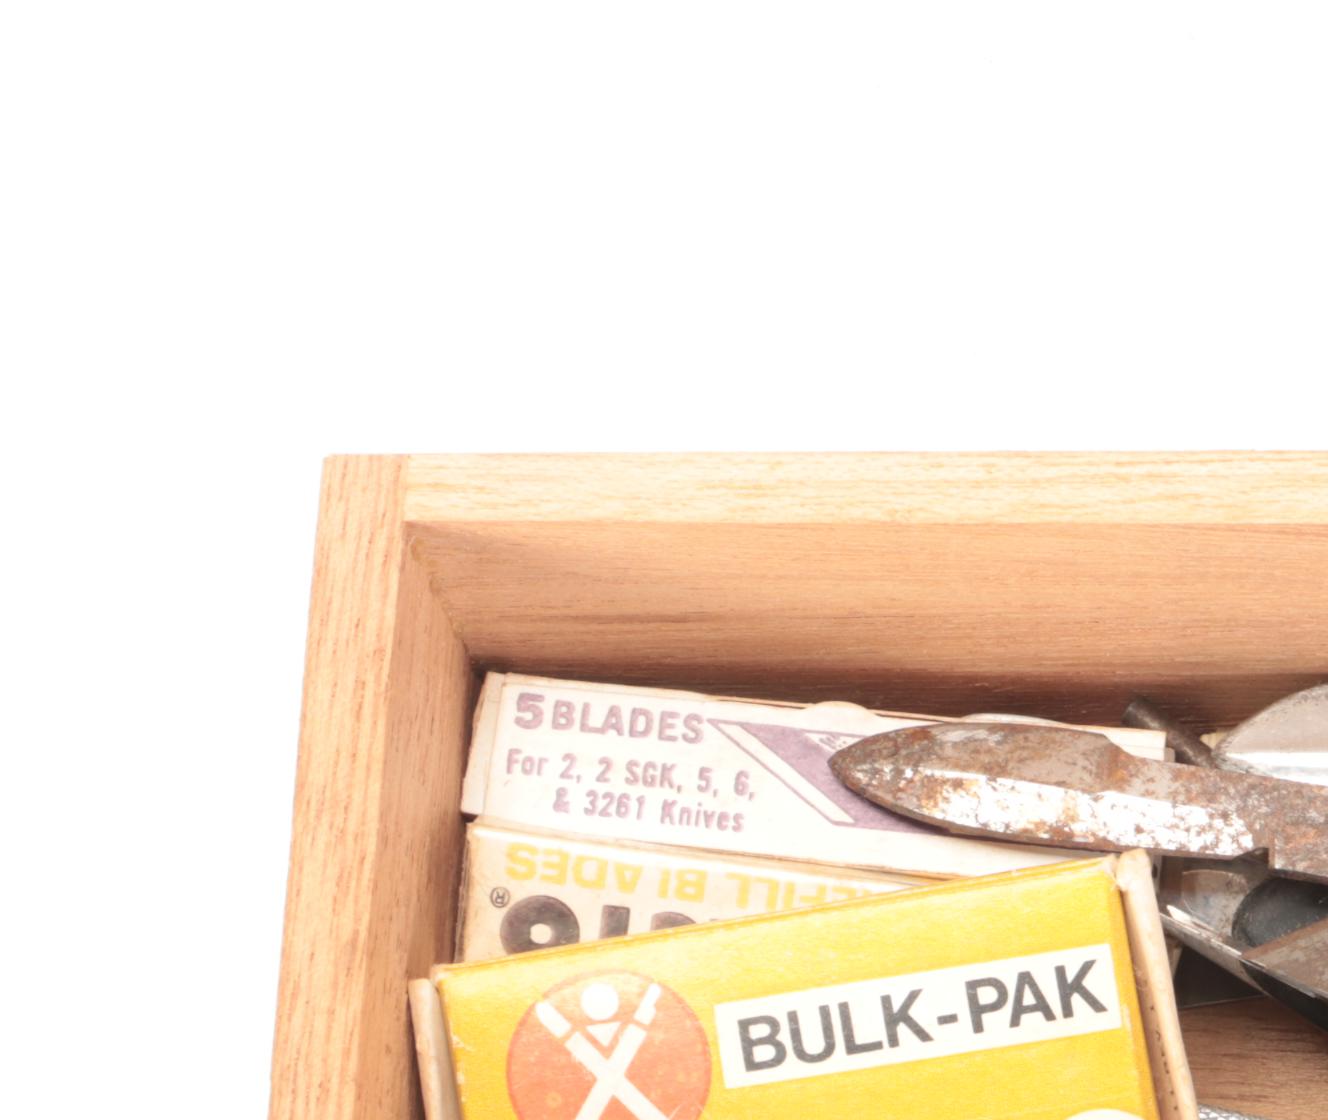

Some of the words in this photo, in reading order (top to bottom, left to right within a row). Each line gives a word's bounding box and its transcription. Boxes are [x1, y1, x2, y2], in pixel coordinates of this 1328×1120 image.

[512, 691, 545, 730] 5
[550, 698, 706, 745] BLADES
[506, 748, 549, 777] For
[559, 752, 583, 783] 2,
[596, 756, 614, 784] 2
[625, 759, 684, 793] SGK,
[697, 767, 719, 799] 5,
[733, 771, 757, 800] 6,
[552, 787, 571, 814] &
[583, 789, 647, 820] 3261
[660, 799, 746, 833] Knives
[736, 958, 1108, 1075] BULK-PAK
